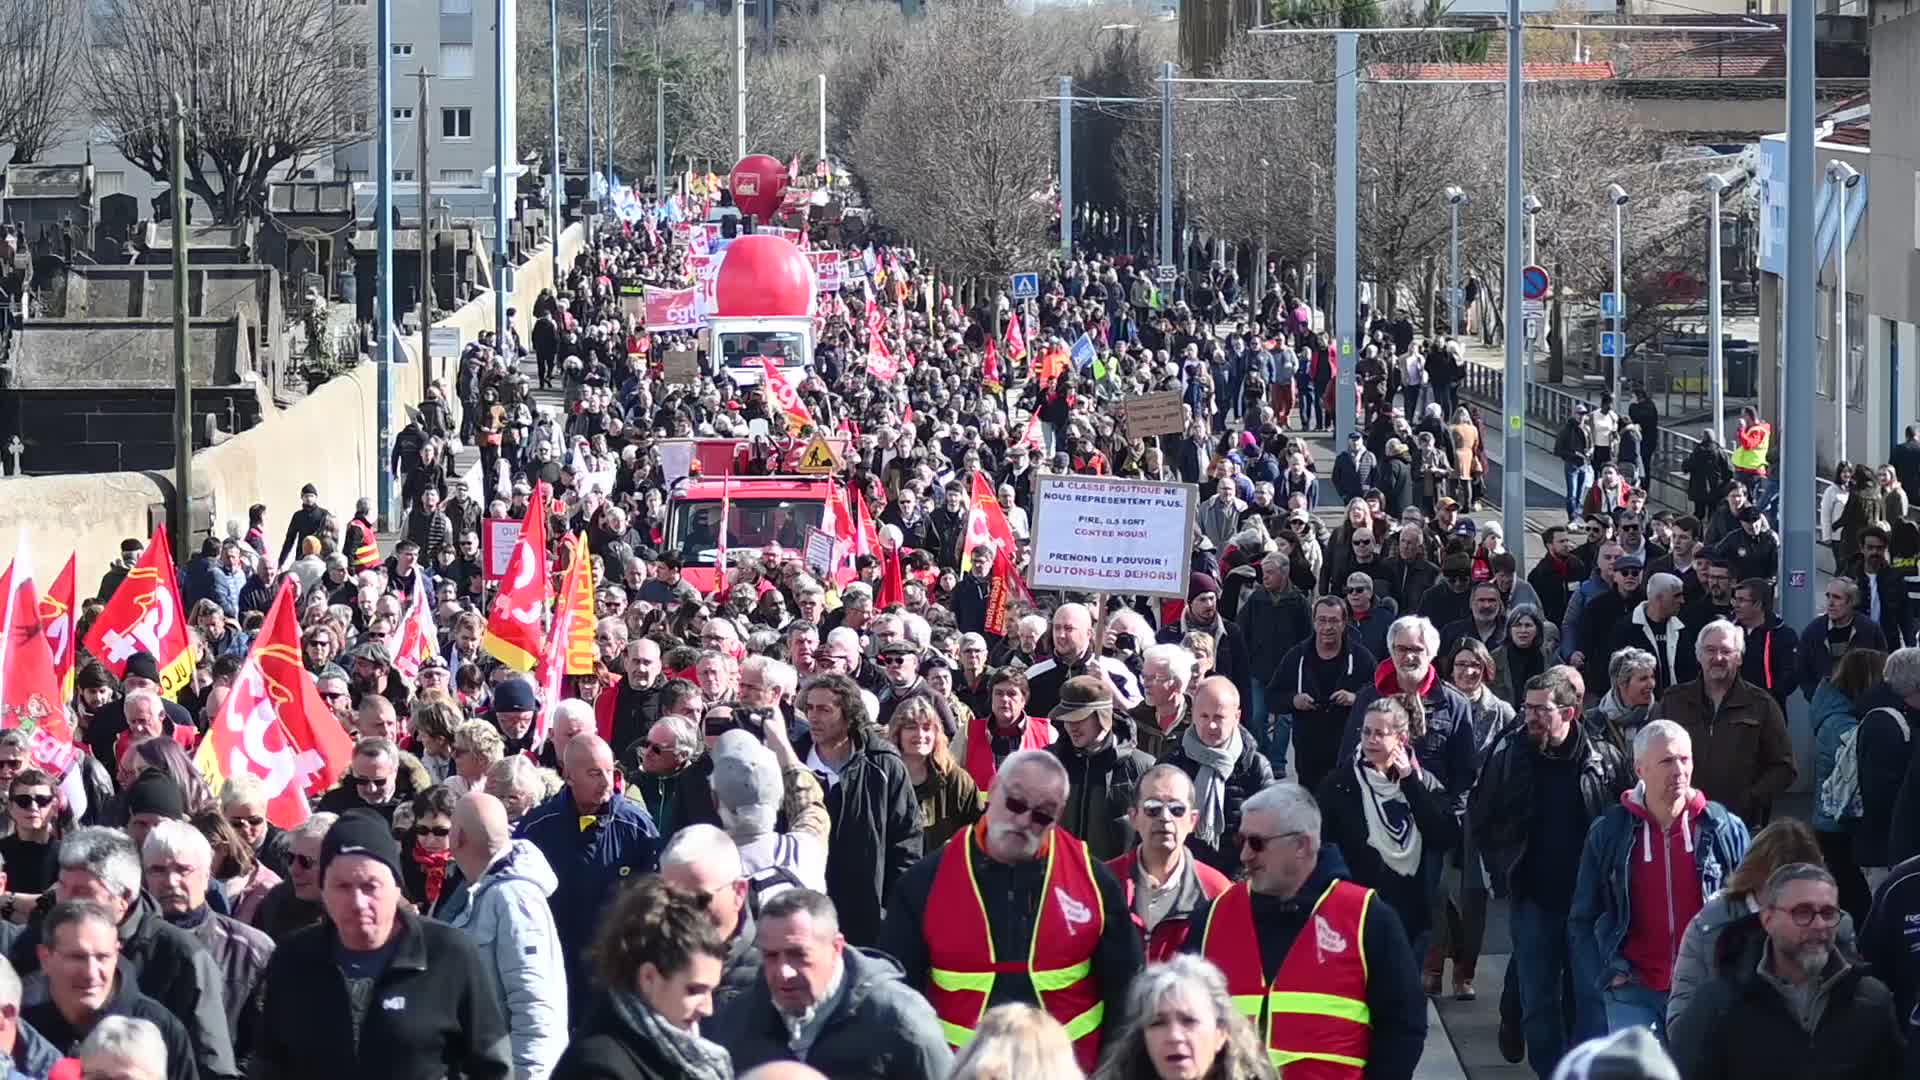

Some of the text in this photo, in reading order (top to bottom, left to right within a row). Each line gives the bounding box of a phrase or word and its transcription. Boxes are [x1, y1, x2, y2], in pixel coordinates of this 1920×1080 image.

[1052, 481, 1177, 496] LA CLASSE POLITIQUE NE
[1043, 492, 1184, 508] NOUS REPRESENTENT PLUS.
[1078, 515, 1104, 525] PIRE,
[1074, 527, 1148, 539] CONTRE NOUS!
[1049, 552, 1098, 562] PRENONS
[1101, 555, 1114, 564] LE
[1116, 556, 1162, 566] POUVOIR
[1038, 564, 1178, 581] FOUTONS-LES DEHORS!
